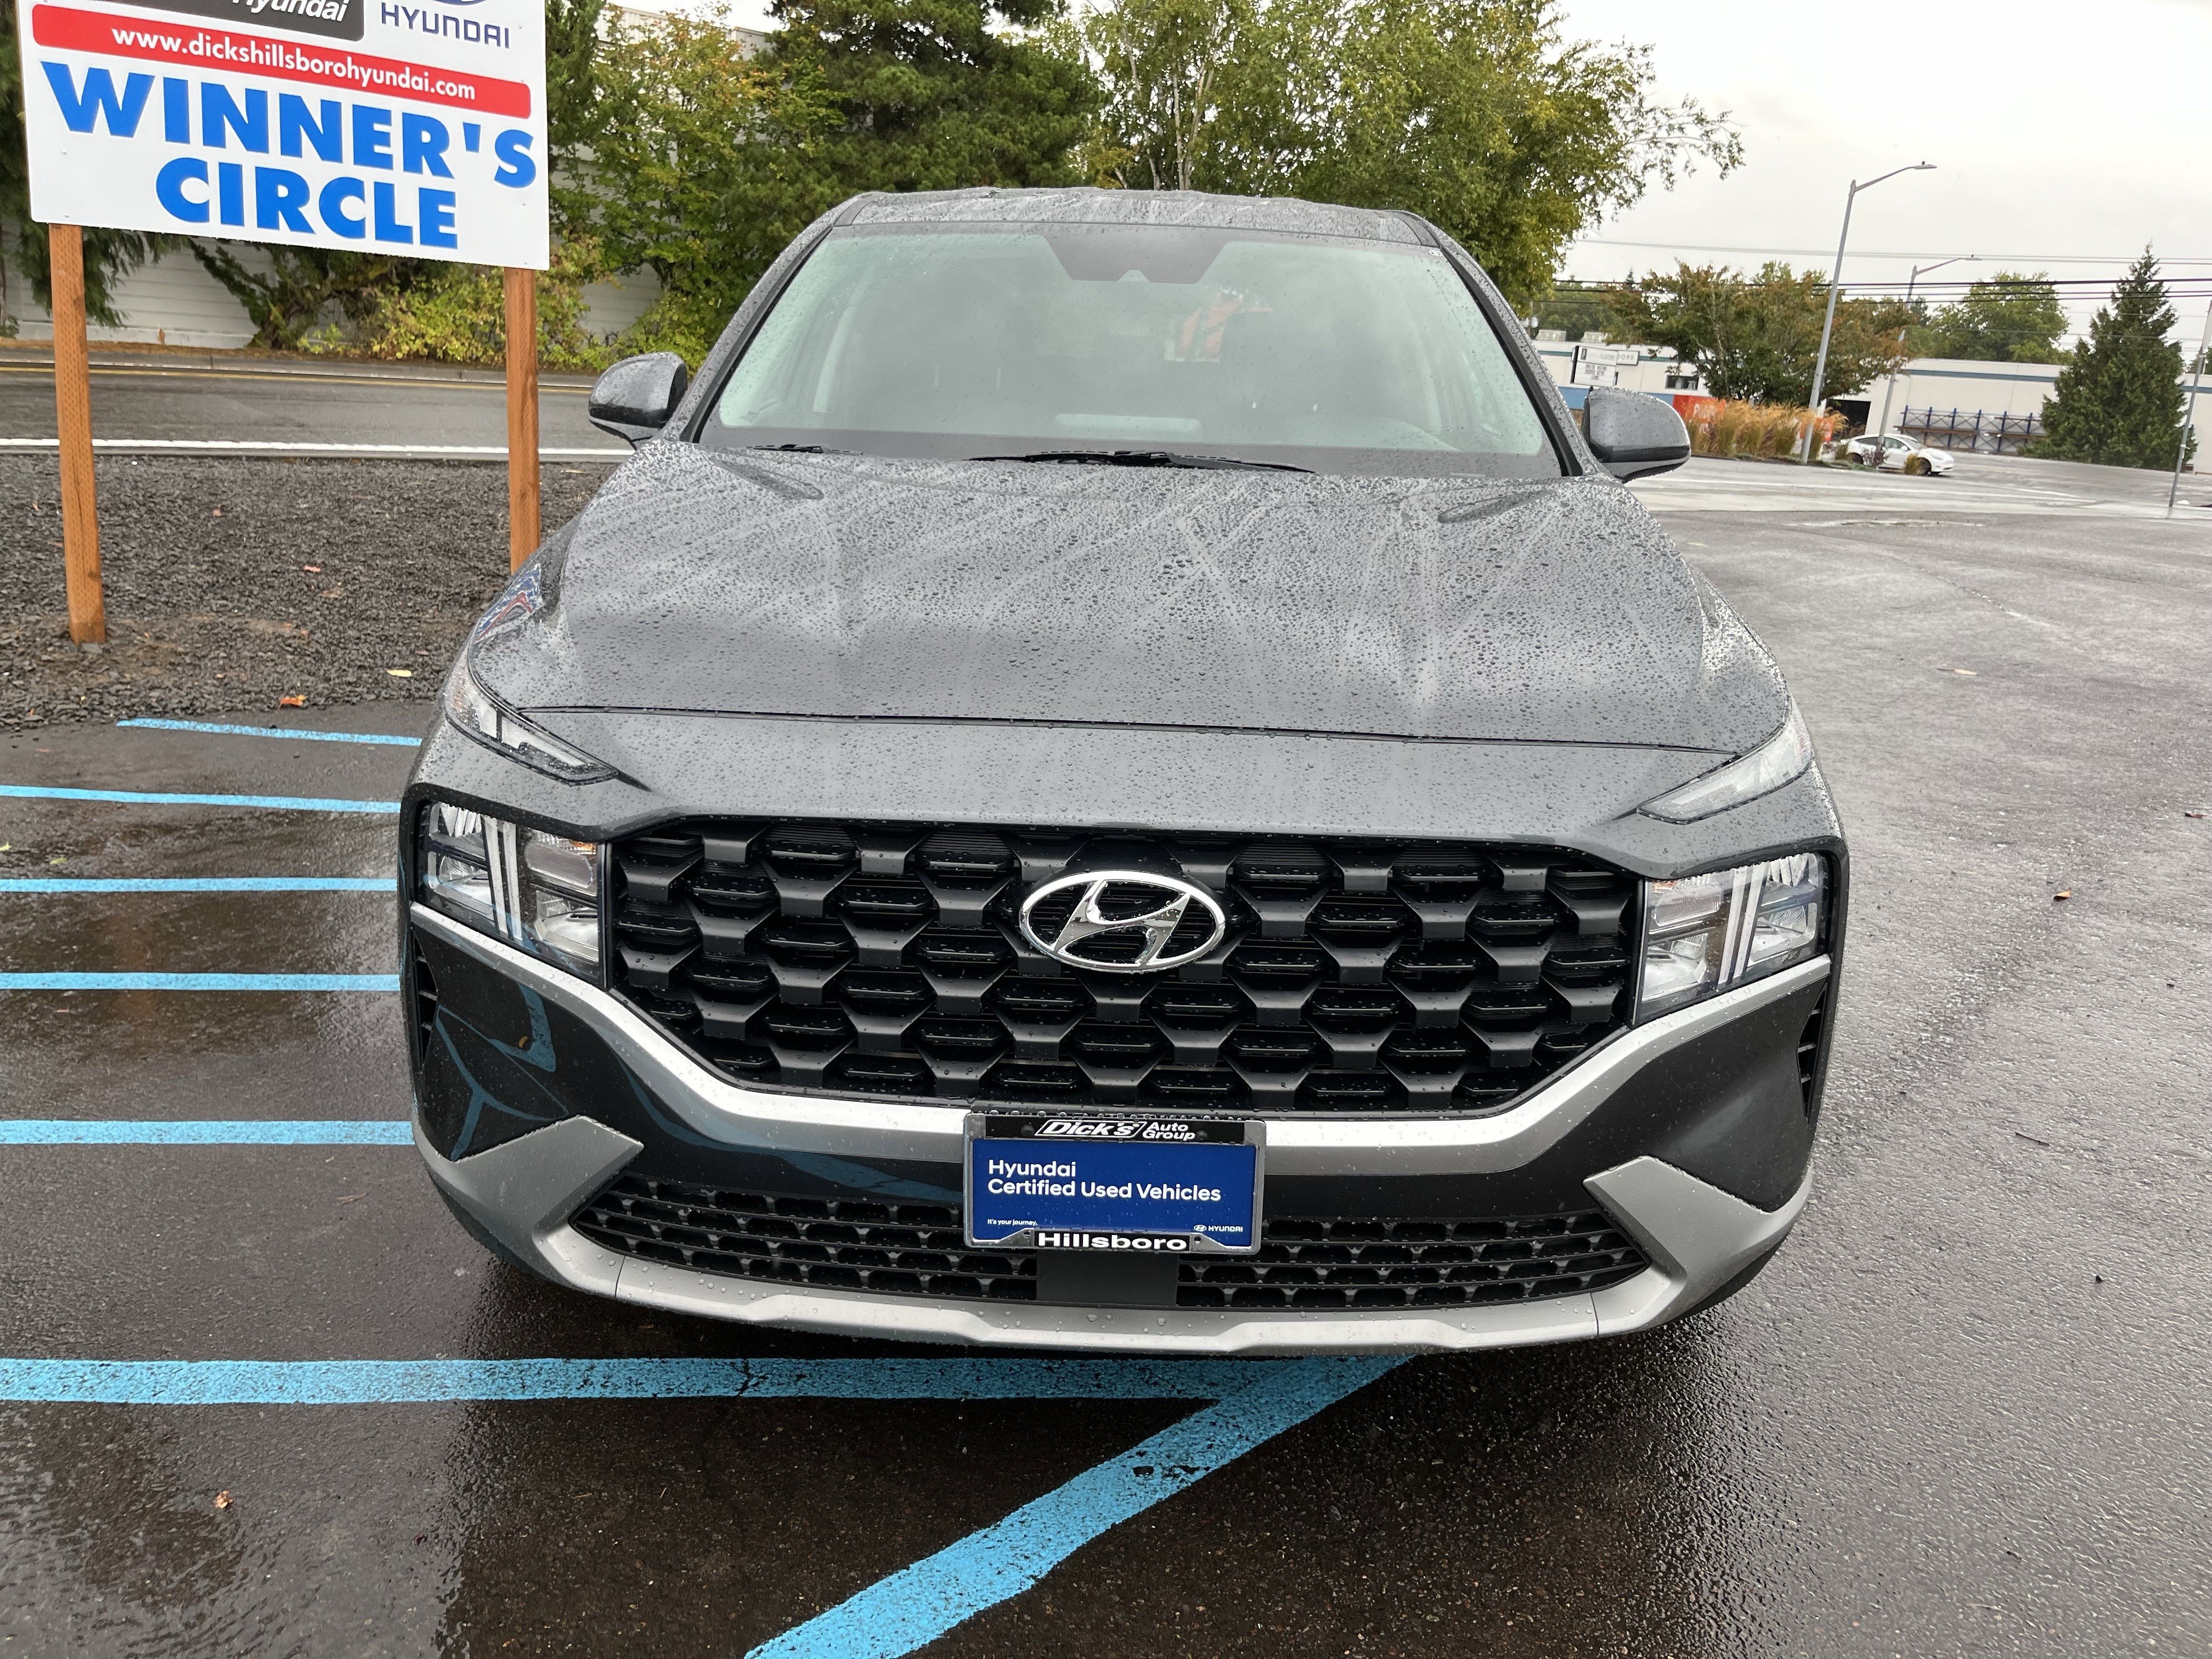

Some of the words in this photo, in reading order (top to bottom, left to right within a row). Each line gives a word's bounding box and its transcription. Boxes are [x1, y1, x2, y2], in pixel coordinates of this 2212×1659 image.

[233, 0, 349, 22] yundai
[381, 2, 509, 49] HYUNDAI
[111, 26, 475, 101] www.dickshillsborohyundai.com
[41, 61, 536, 188] WINNER'S
[156, 157, 458, 249] CIRCLE
[1142, 1130, 1195, 1141] Group
[1147, 1122, 1188, 1131] Auto
[988, 1159, 1076, 1178] Hyundai
[988, 1178, 1075, 1196] Certified
[1081, 1182, 1132, 1198] Used
[1136, 1183, 1221, 1201] Vehicles
[1038, 1233, 1187, 1250] Hillsboro
